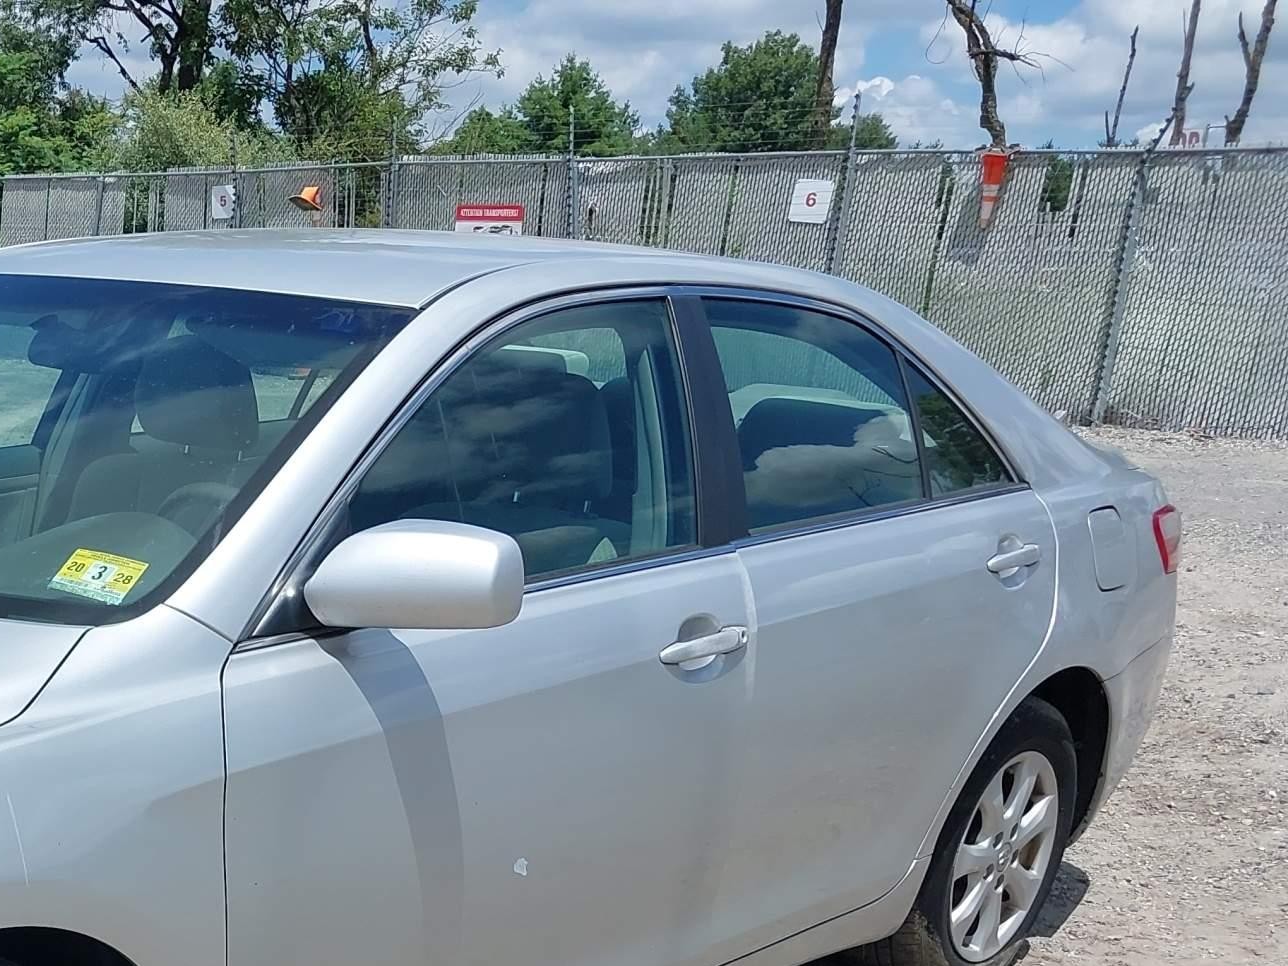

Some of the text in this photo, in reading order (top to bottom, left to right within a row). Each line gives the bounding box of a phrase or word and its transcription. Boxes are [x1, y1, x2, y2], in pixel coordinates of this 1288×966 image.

[220, 195, 227, 207] 5
[805, 192, 817, 207] 6
[66, 561, 133, 585] 20 3 28
